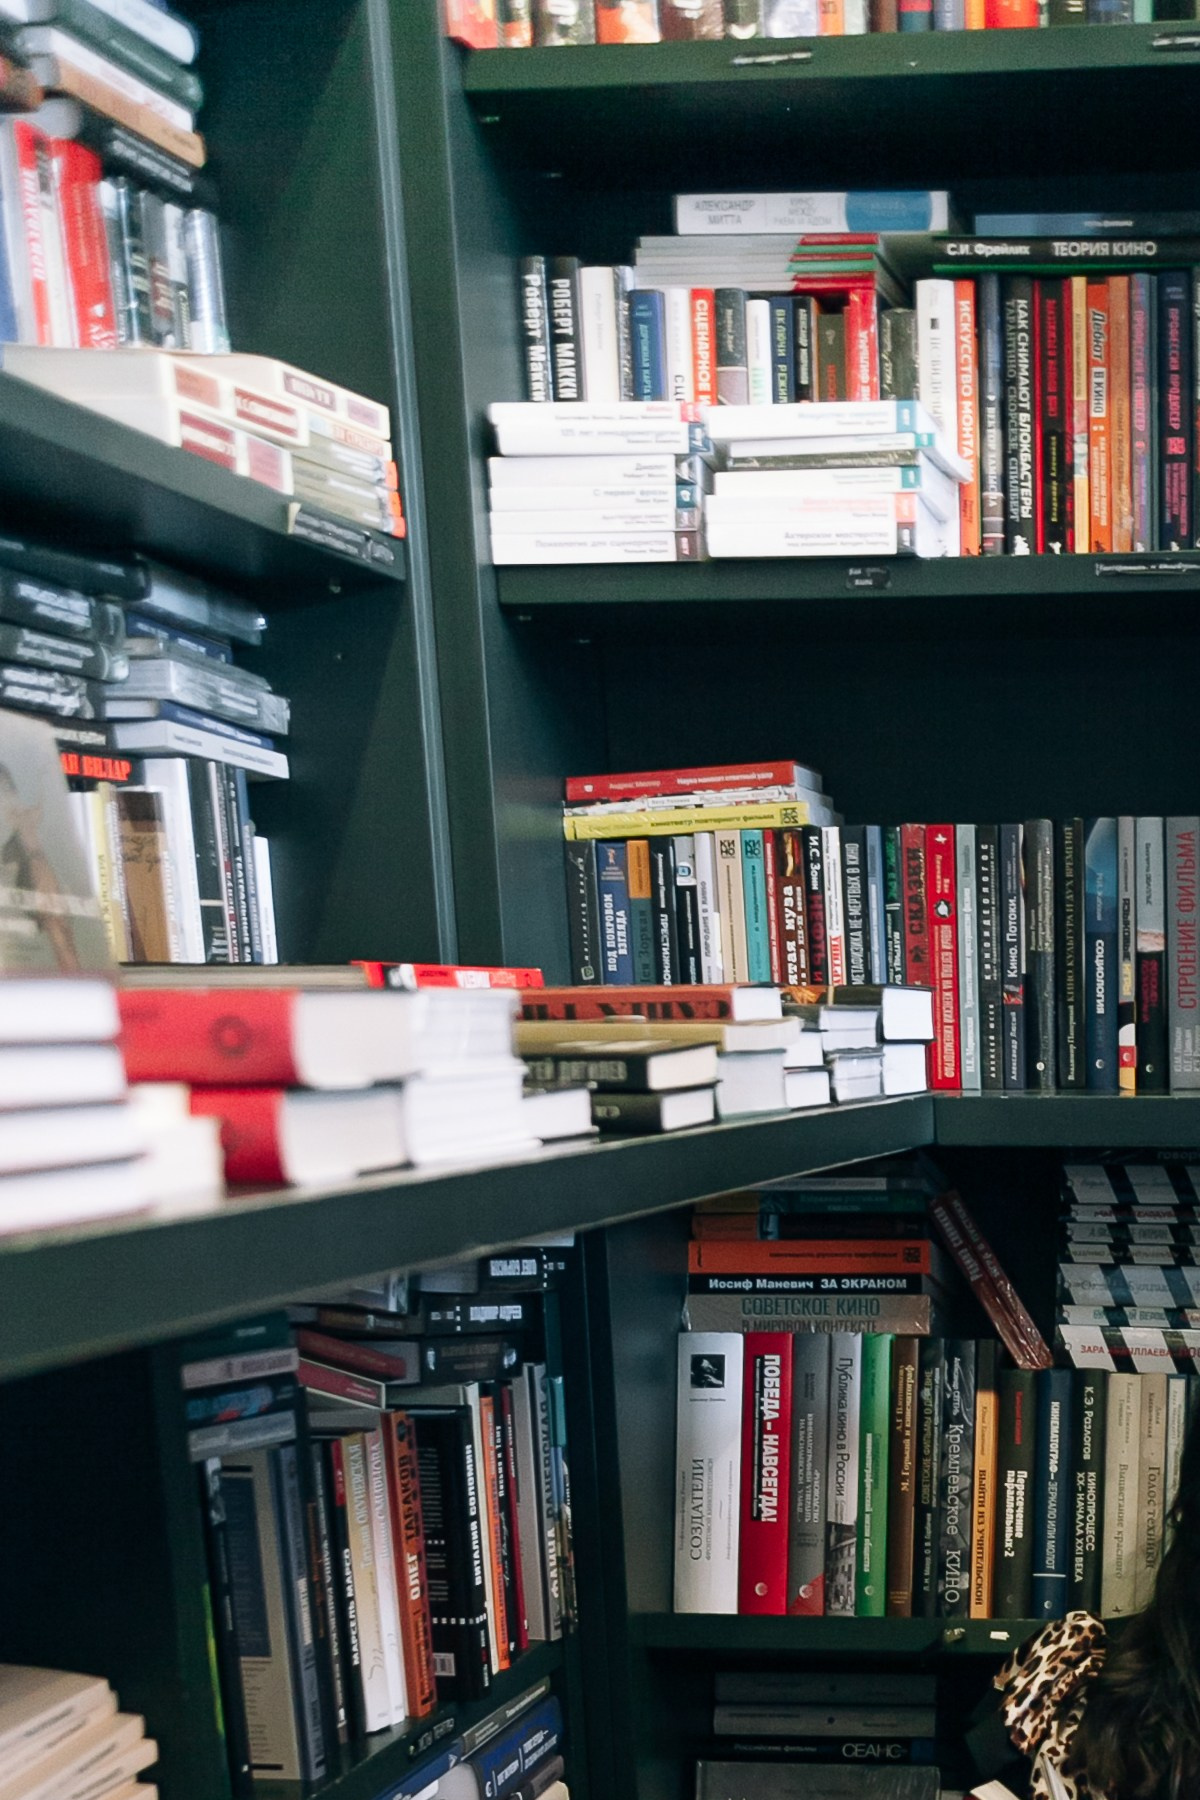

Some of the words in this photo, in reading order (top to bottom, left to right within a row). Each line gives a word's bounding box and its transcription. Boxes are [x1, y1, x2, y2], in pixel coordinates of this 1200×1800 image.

[1053, 242, 1108, 256] ТЕОРИЯ
[1113, 241, 1157, 255] КИНО
[552, 279, 574, 336] РОБЕРТ
[1019, 299, 1030, 325] КАК
[695, 300, 712, 391] СЦЕНАРНОЕ
[1091, 309, 1106, 362] Дебют
[555, 342, 578, 400] МАККИ
[1019, 330, 1031, 411] СНИМАЮТ
[1093, 381, 1104, 414] КИНО
[1020, 412, 1033, 520] БЛОКБАСТЕРЫ
[845, 843, 859, 865] КИНО
[1176, 831, 1195, 912] ФИЛЬМА
[847, 876, 861, 929] НЕ-МЕРТВЫХ
[907, 848, 924, 935] СКАЗКИ
[1006, 896, 1018, 942] Потоки.
[603, 894, 615, 947] ПОКРОВОМ
[616, 910, 628, 955] ВЗГЛЯДА
[607, 950, 618, 971] ПОД
[850, 931, 864, 985] МЕТАФИЗИКА
[1007, 944, 1018, 977] Кино.
[1096, 939, 1105, 1014] СОЦИОЛОГИЯ
[1177, 918, 1197, 1009] СТРОЕНИЕ
[709, 1278, 753, 1290] Иосиф
[756, 1278, 814, 1290] Маневич
[820, 1278, 838, 1290] ЗА
[841, 1278, 907, 1290] ЭКРАНОМ
[741, 1298, 831, 1317] СОВЕТСКОЕ
[838, 1298, 881, 1317] КИНО
[760, 1355, 780, 1419] ПОБЕДА
[1048, 1401, 1060, 1473] КИНЕМАТОГРАФ
[398, 1454, 418, 1543] ТАБАКОВ
[464, 1444, 478, 1515] СОЛОМИН
[758, 1434, 779, 1522] НАВСЕГДА!
[946, 1423, 963, 1534] Кремлевское
[1014, 1470, 1027, 1538] Пересечение
[1047, 1481, 1058, 1519] ЗЕРКАЛО
[1147, 1466, 1160, 1502] Голос
[690, 1459, 704, 1560] СОЗДАТЕЛИ
[1086, 1471, 1096, 1551] КИНОПРОЦЕСС
[1145, 1506, 1156, 1568] техники
[343, 1548, 355, 1598] МАРСО
[406, 1552, 421, 1601] ОЛЕГ
[468, 1519, 483, 1586] ВИТАЛИЙ
[945, 1550, 960, 1602] КИНО
[1046, 1540, 1055, 1569] МОЛОТ
[345, 1601, 360, 1665] МАРСЕЛЬ
[842, 1744, 902, 1759] СЕАНС
